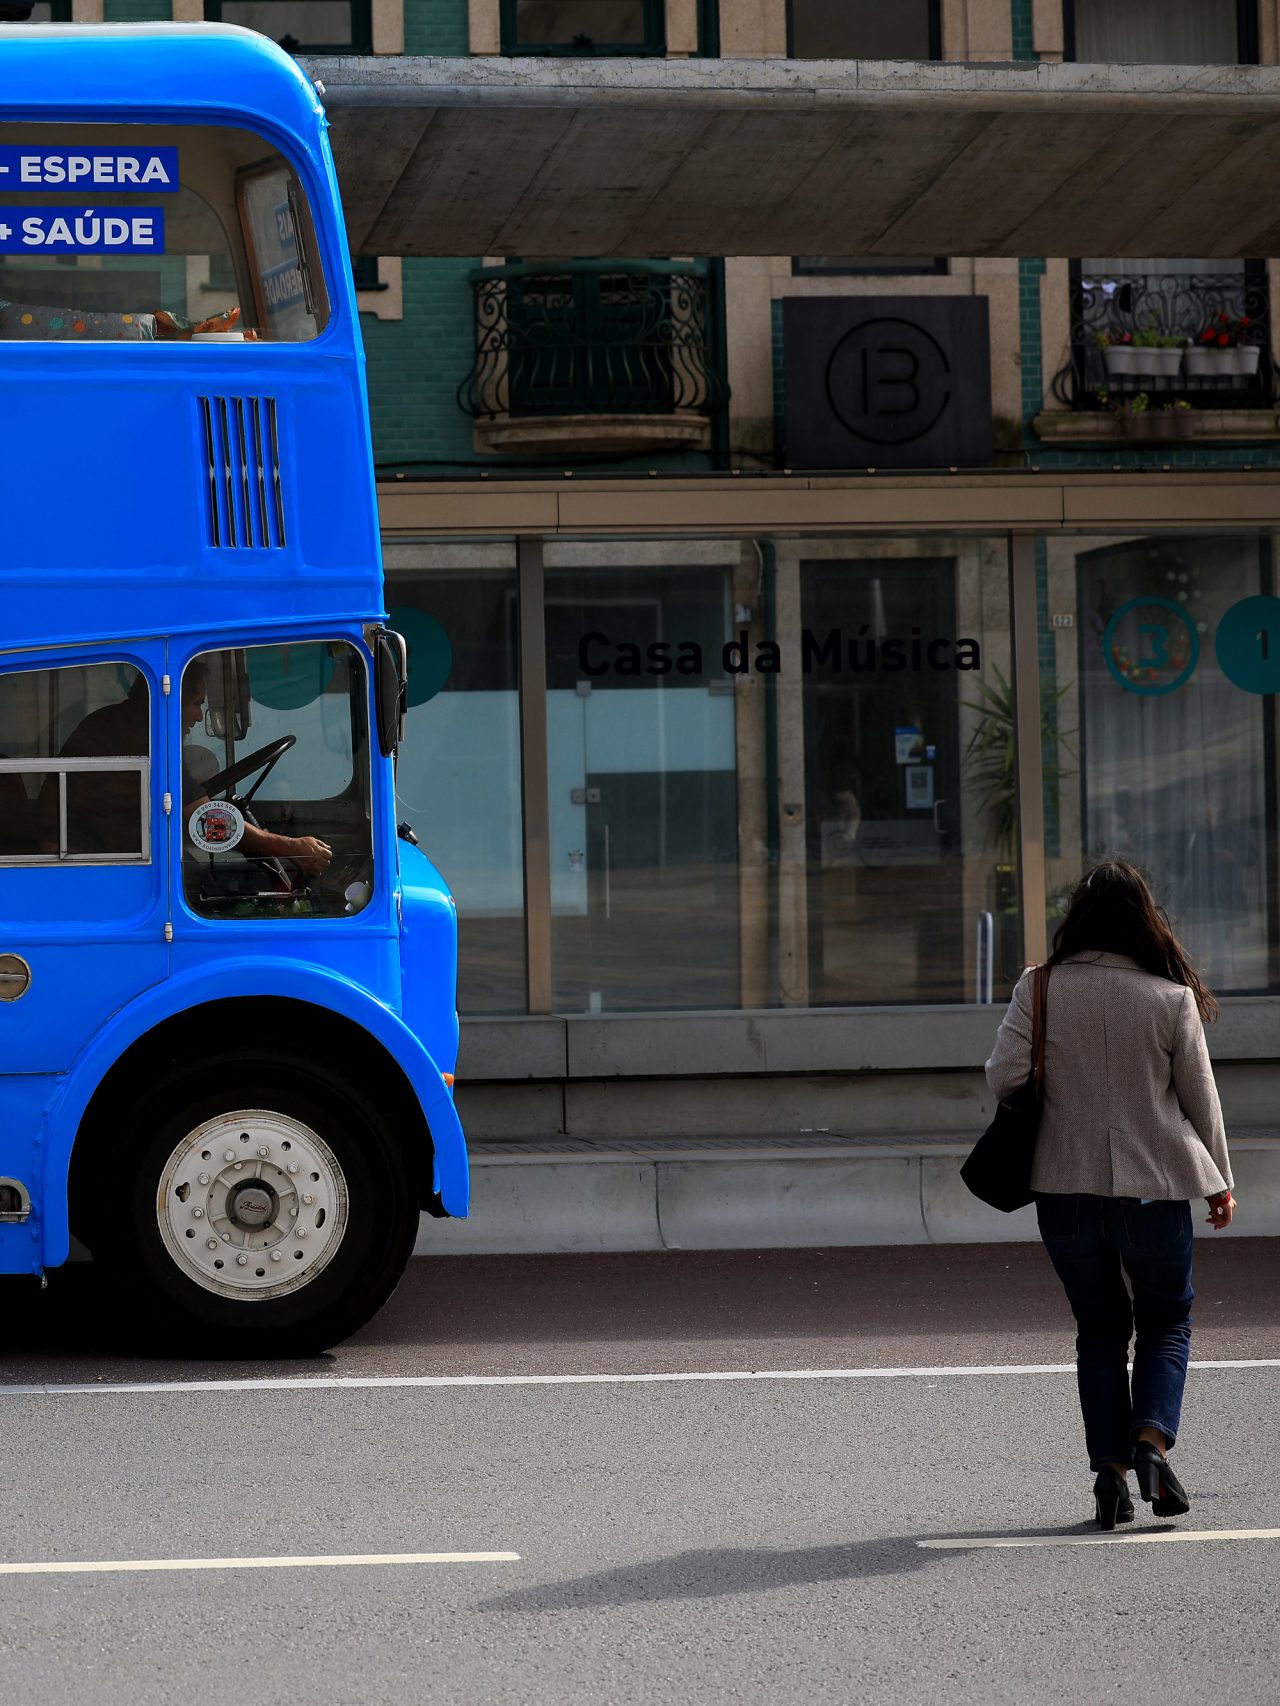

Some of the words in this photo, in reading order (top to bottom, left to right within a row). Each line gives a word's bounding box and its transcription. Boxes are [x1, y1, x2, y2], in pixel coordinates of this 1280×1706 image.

[20, 155, 171, 184] ESPERA
[22, 209, 154, 246] SAÚDE
[577, 631, 703, 677] Casa
[722, 630, 782, 675] da
[801, 624, 982, 675] Música
